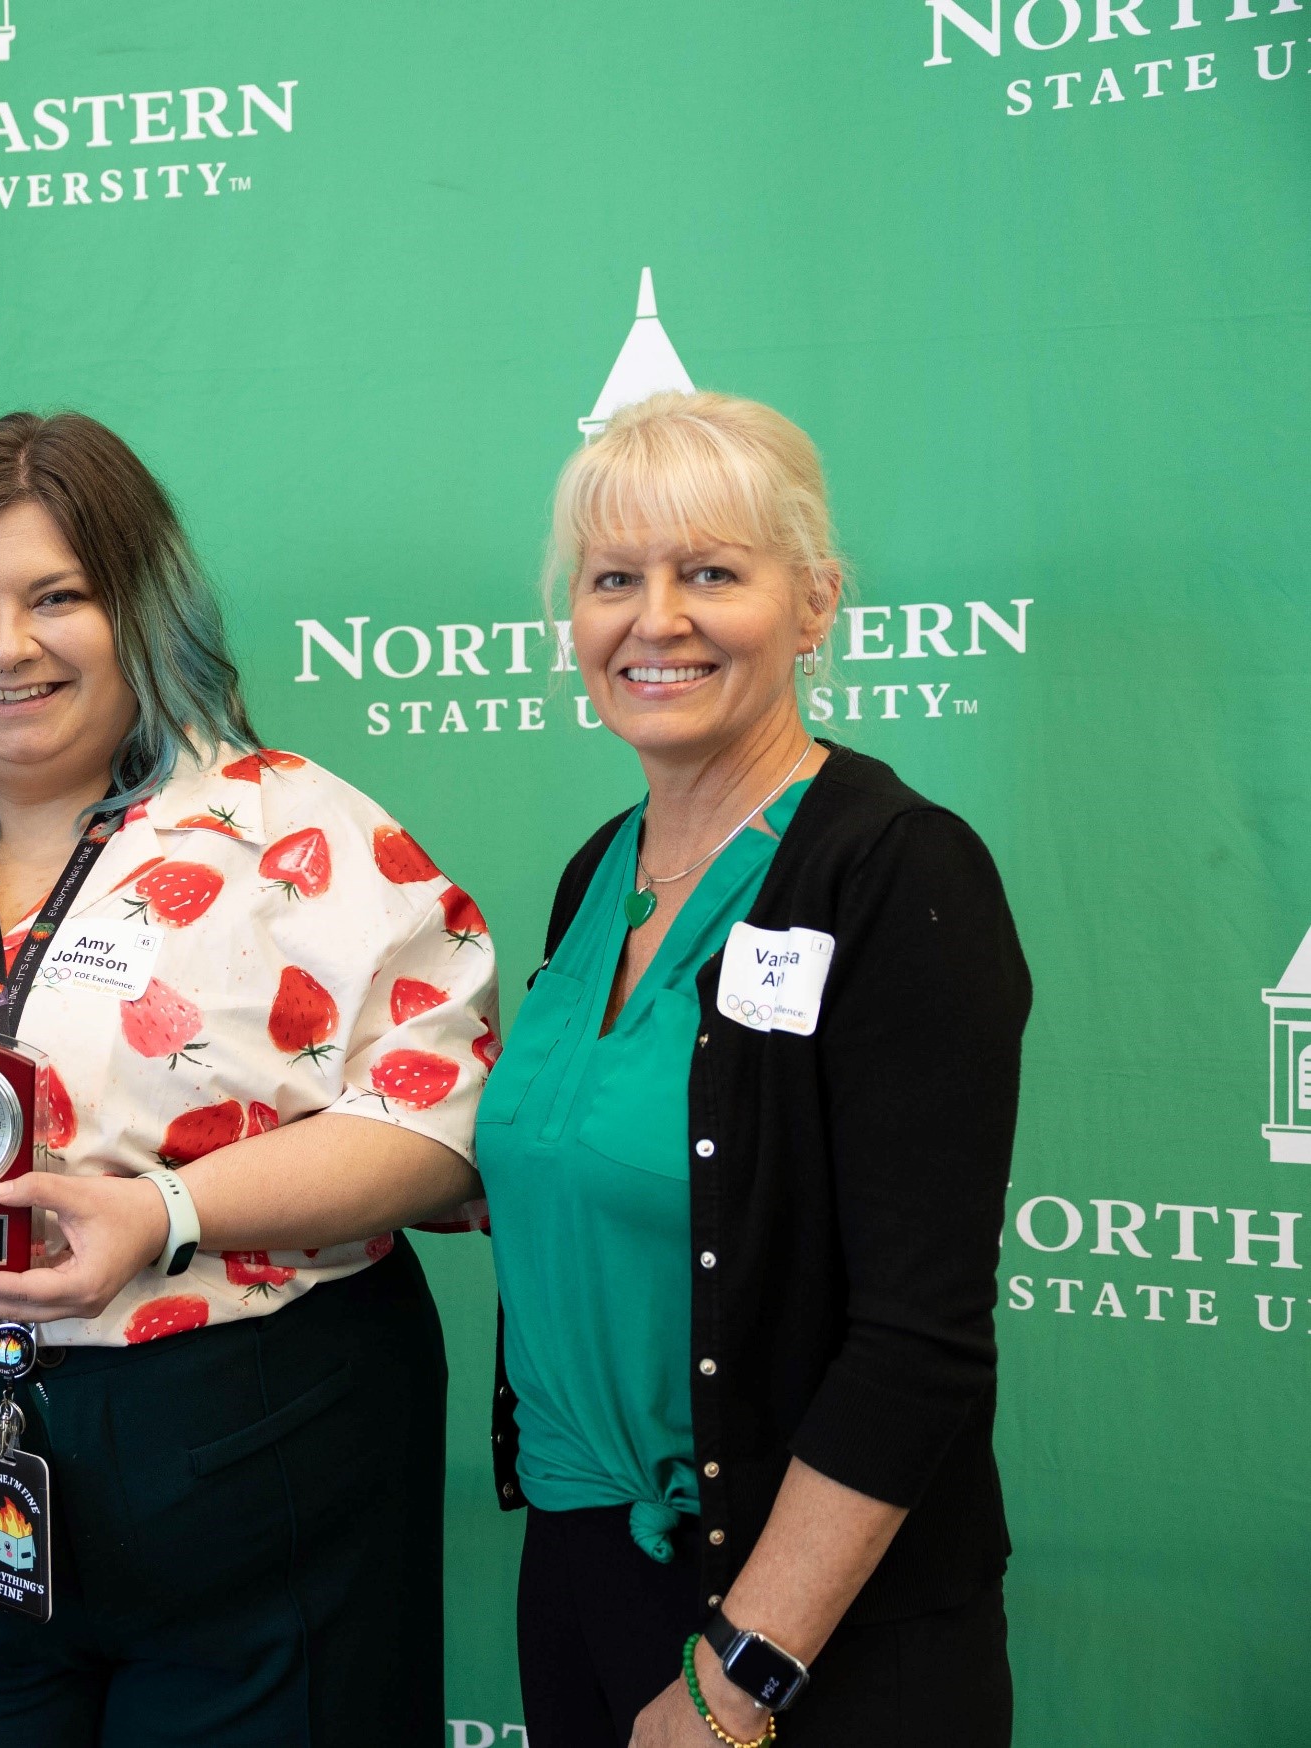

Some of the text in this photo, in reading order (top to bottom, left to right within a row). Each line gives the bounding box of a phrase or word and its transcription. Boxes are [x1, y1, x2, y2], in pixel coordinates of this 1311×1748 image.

[1007, 53, 1219, 116] STATE
[367, 698, 546, 736] STATE
[74, 936, 116, 955] Amy
[51, 950, 128, 973] Johnson
[74, 971, 136, 991] COE Excellence:
[1008, 1275, 1219, 1326] STATE
